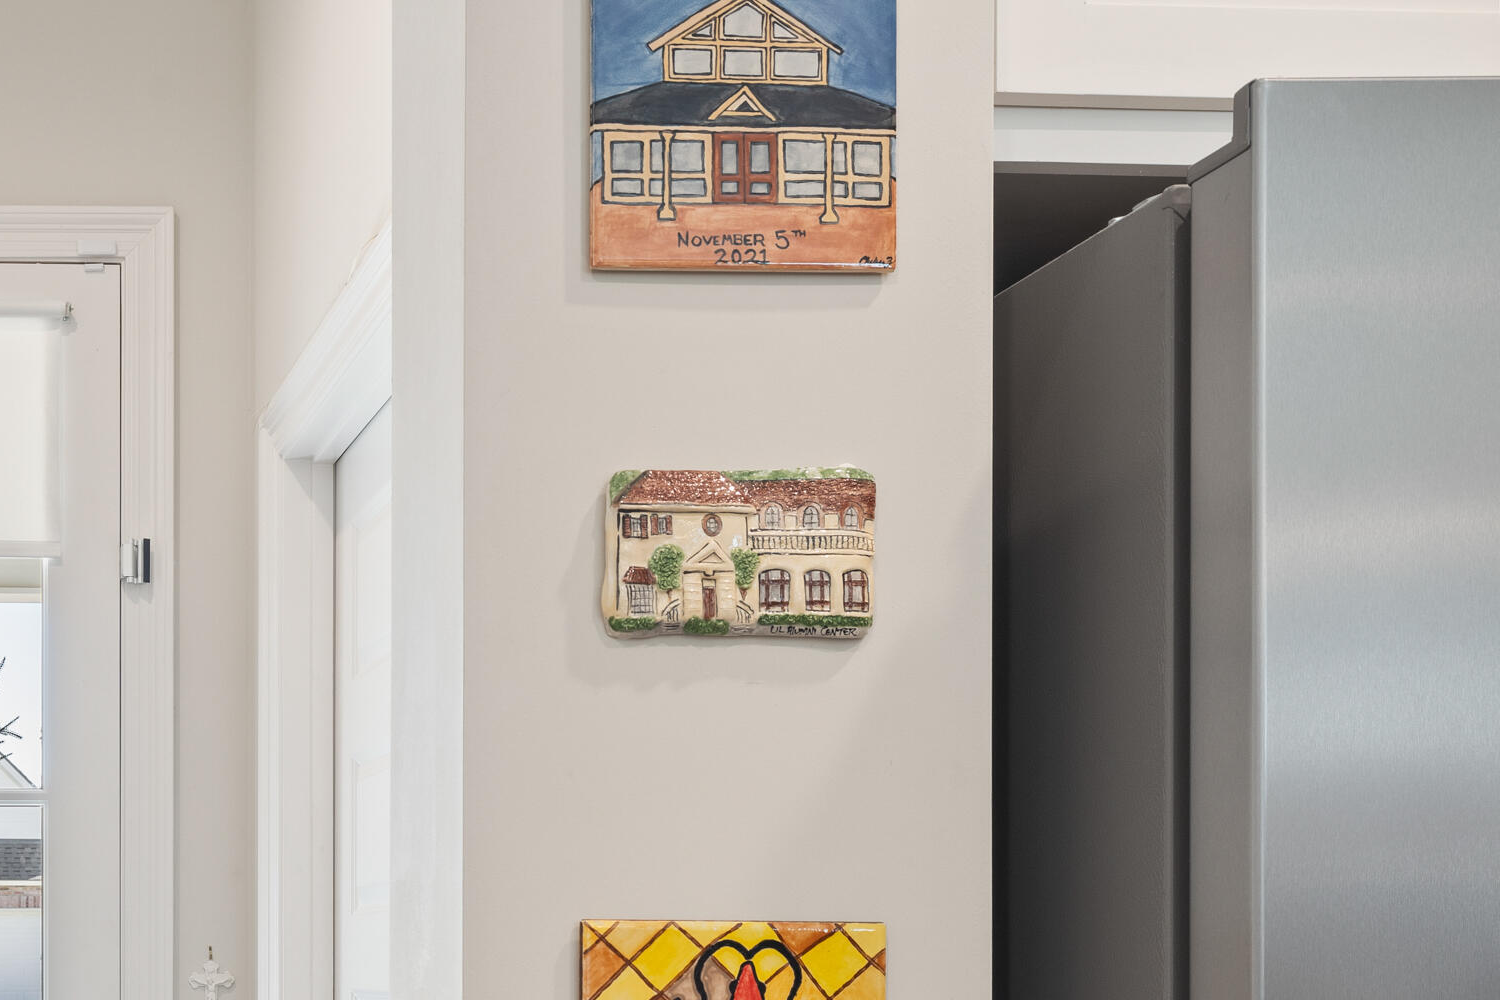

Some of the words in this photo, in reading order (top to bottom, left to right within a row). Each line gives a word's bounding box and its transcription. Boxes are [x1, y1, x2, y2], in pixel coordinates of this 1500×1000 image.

[677, 231, 765, 247] NOVEMBER
[714, 248, 770, 264] 2021
[820, 625, 857, 637] CENTER
